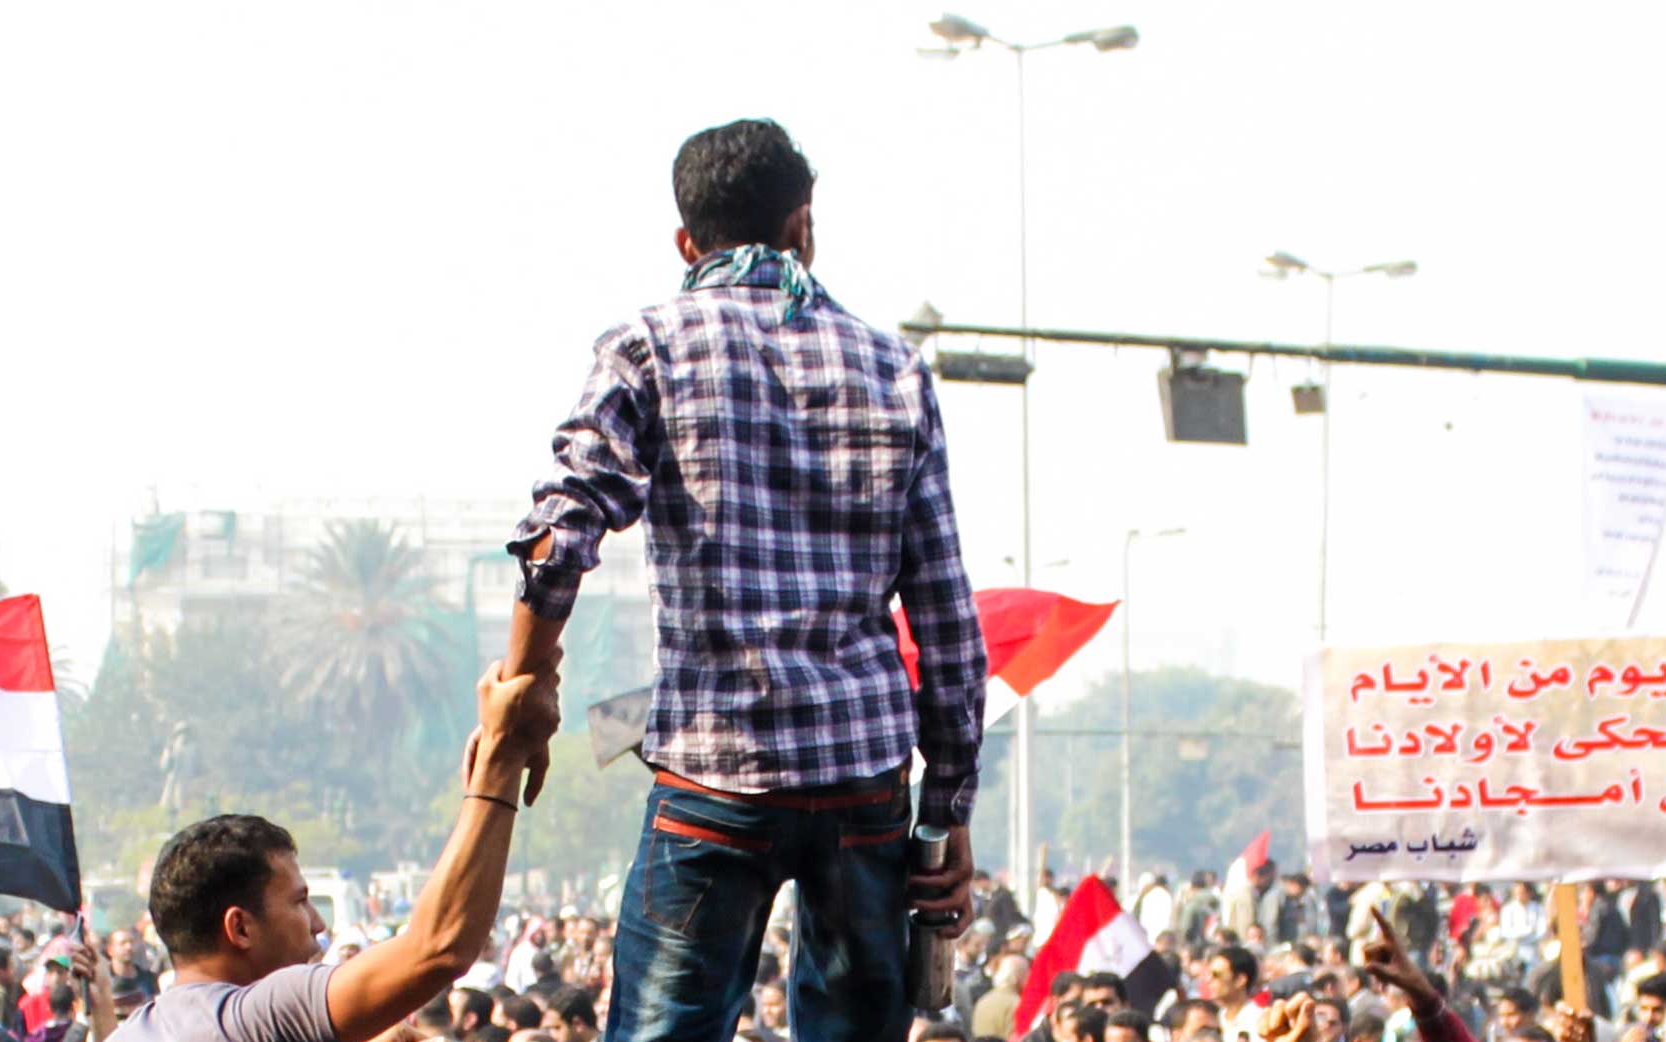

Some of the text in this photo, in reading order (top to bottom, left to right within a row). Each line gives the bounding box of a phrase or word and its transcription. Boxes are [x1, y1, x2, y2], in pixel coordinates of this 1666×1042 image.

[1350, 654, 1490, 704] الأيام
[1508, 658, 1571, 699] من
[1346, 715, 1536, 763] لأولادنا
[1353, 768, 1642, 816] أمجادنا
[1344, 827, 1479, 861] شباب مصر
